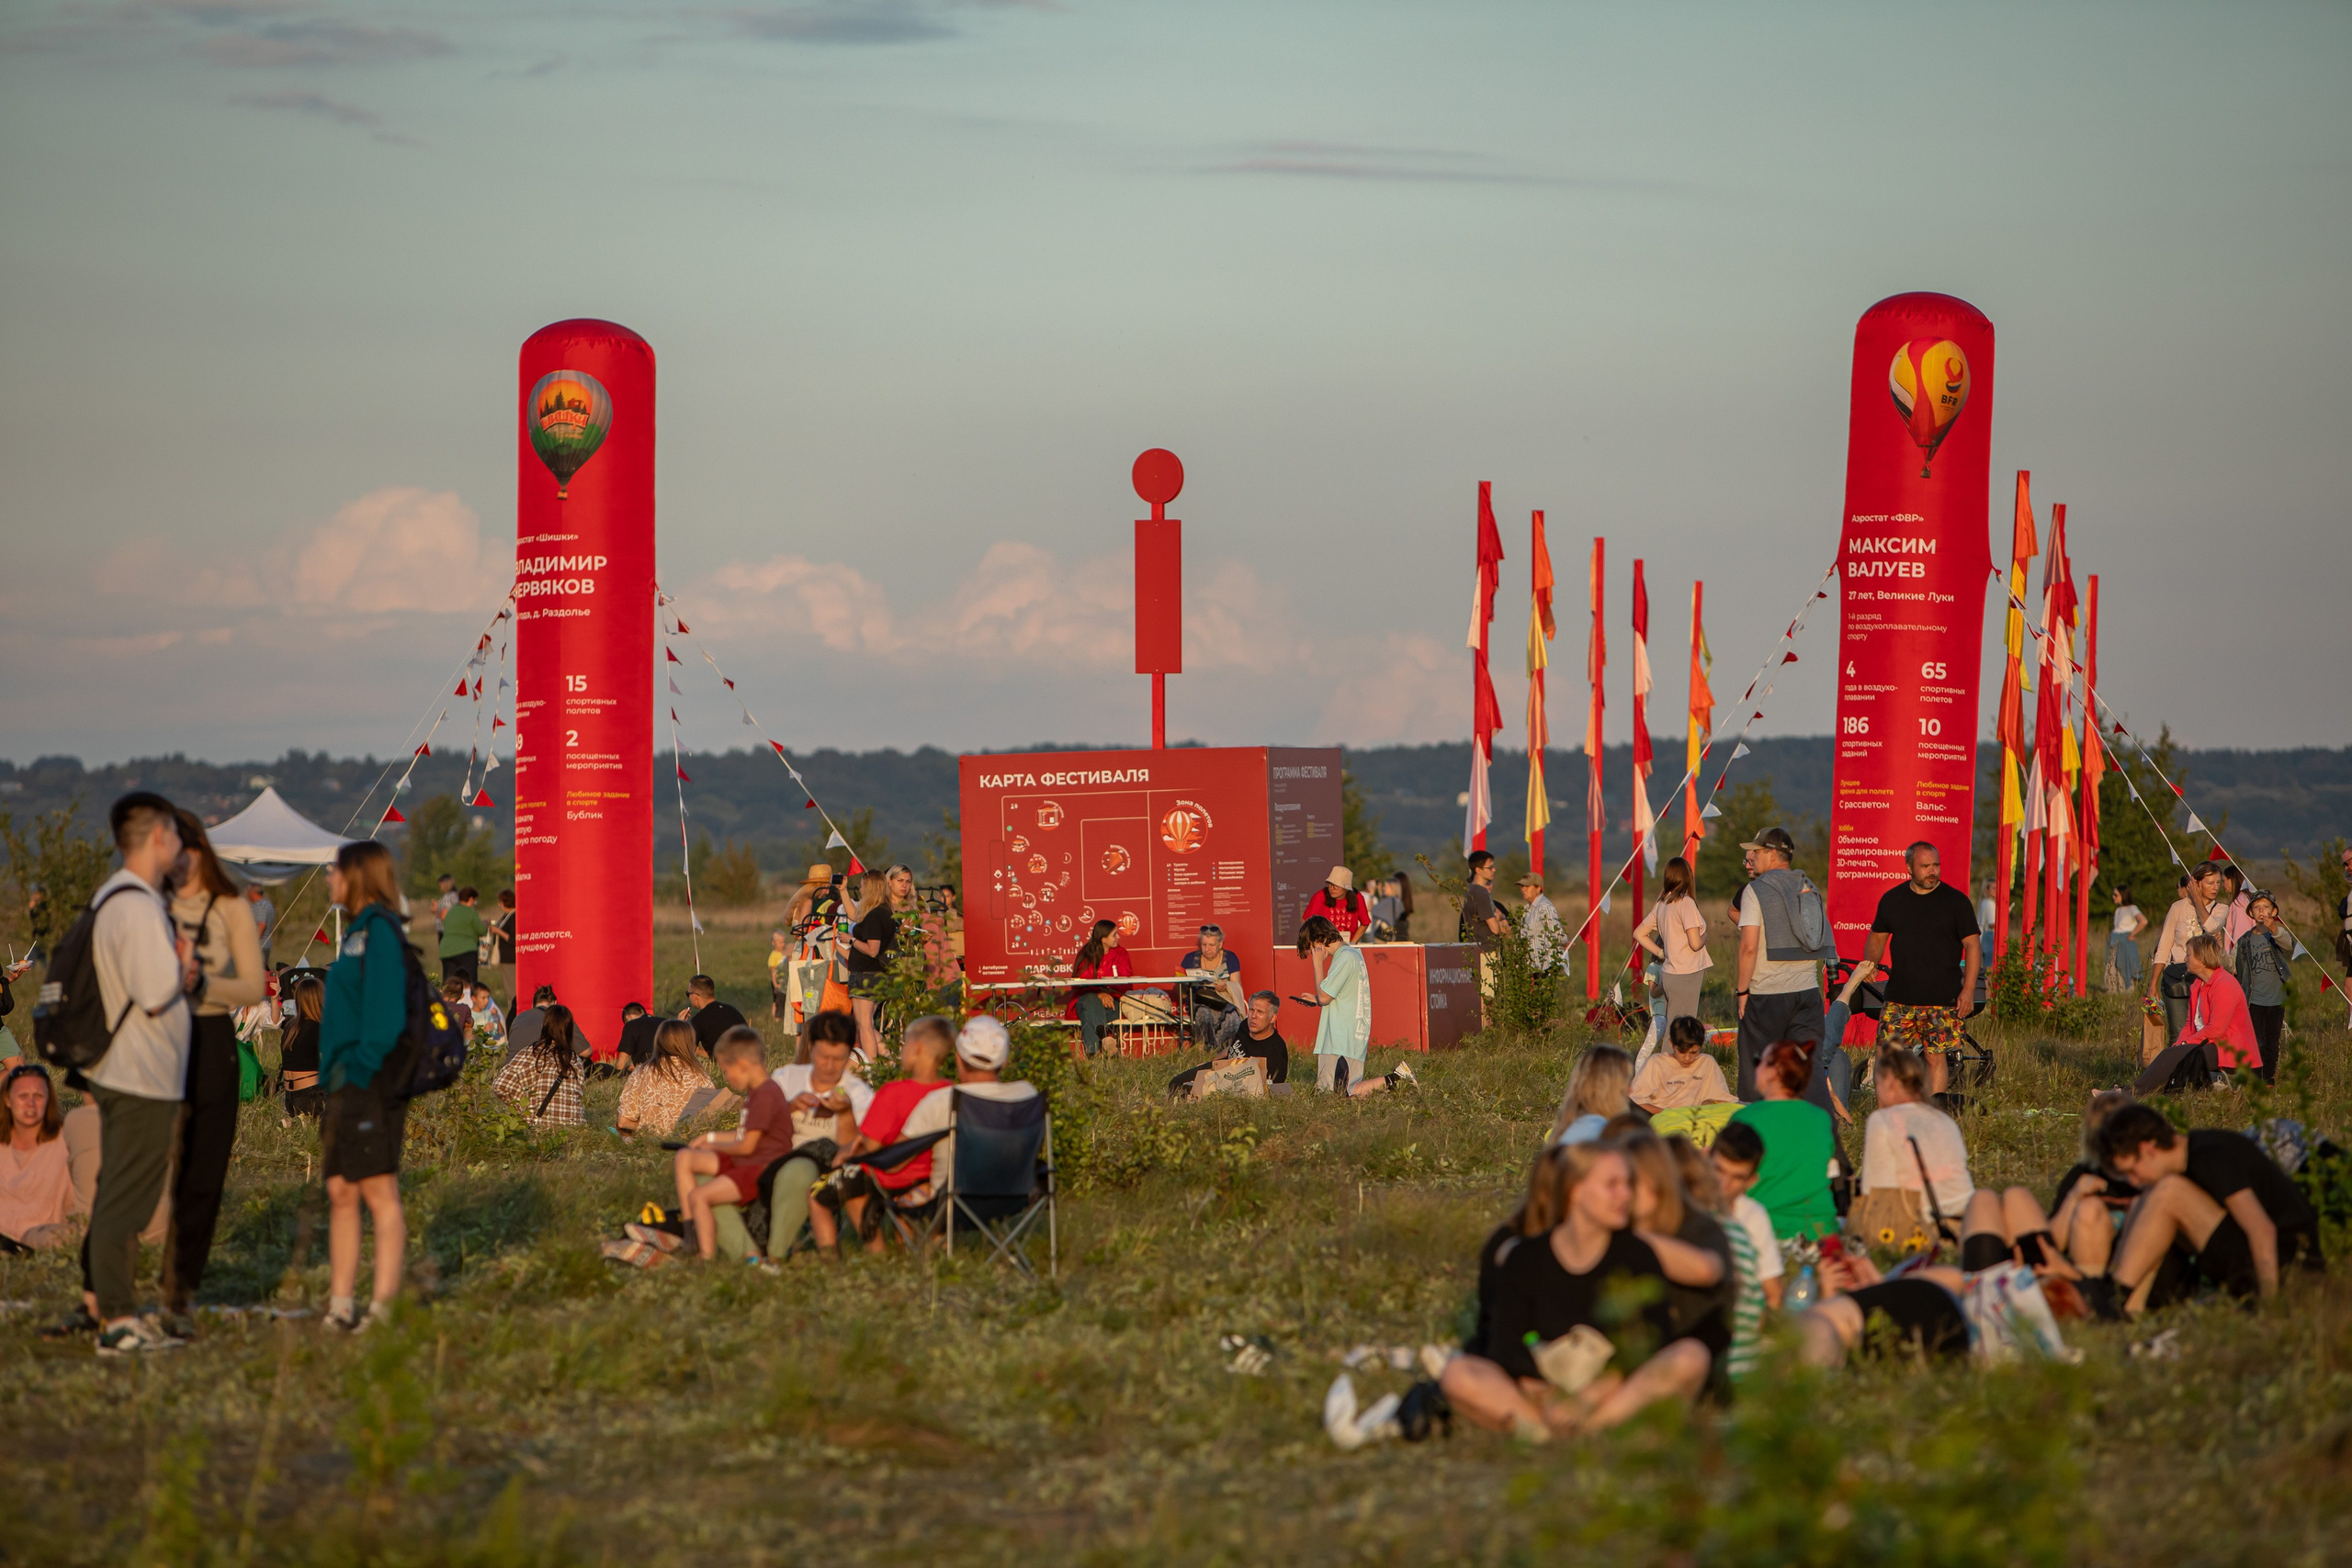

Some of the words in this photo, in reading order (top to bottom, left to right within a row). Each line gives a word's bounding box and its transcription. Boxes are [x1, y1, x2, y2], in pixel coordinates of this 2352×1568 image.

[1941, 395, 1958, 407] BFR
[1851, 514, 1888, 524] Аэростат
[1890, 513, 1924, 523] «ФВР»
[536, 534, 579, 542] «Шишки»
[1849, 537, 1937, 555] МАКСИМ
[1848, 561, 1926, 579] ВАЛУЕВ
[1848, 591, 1857, 601] 27
[1858, 592, 1875, 601] лет,
[1877, 591, 1925, 601] Великие
[1928, 592, 1954, 604] Луки
[542, 607, 591, 618] Раздолье
[1856, 613, 1882, 622] разряд
[1855, 623, 1947, 633] воздухоплавательному
[1847, 633, 1868, 641] спорту
[1846, 660, 1856, 678] 4
[1921, 661, 1947, 680] 65
[565, 675, 587, 693] 15
[1863, 684, 1898, 693] воздухо-
[1920, 685, 1966, 695] спортивных
[566, 697, 616, 706] спортивных
[1844, 694, 1875, 702] плавании
[1920, 695, 1953, 705] полетов
[566, 707, 601, 716] полетов
[1843, 716, 1870, 734] 186
[1918, 718, 1941, 736] 10
[566, 730, 579, 747] 2
[1842, 740, 1883, 749] спортивных
[1918, 741, 1965, 751] посещенных
[566, 752, 619, 761] посещенных
[1841, 749, 1868, 758] заданий
[1917, 751, 1967, 761] мероприятий
[566, 761, 623, 771] мероприятия
[979, 773, 1036, 788] КАРТА
[1040, 769, 1149, 786] ФЕСТИВАЛЯ
[1917, 781, 1950, 791] Любимое
[566, 790, 601, 799] Любимое
[603, 791, 630, 799] задание
[1869, 788, 1894, 796] полета
[1922, 790, 1946, 798] спорте
[572, 798, 598, 807] спорте
[1839, 800, 1845, 808] С
[1845, 800, 1890, 811] рассветом
[1917, 801, 1947, 811] Вальс-
[567, 810, 603, 820] Бублик
[1193, 803, 1214, 829] полетов
[1916, 814, 1959, 825] сомнение
[529, 835, 558, 845] погоду
[1838, 834, 1879, 845] Объемное
[1837, 859, 1878, 869] 3D-печать,
[1837, 871, 1911, 881] программирован
[1834, 921, 1871, 931] «Главное
[529, 931, 572, 941] делается,
[519, 943, 556, 954] лучшему»
[1024, 964, 1074, 974] ПАРКОВК
